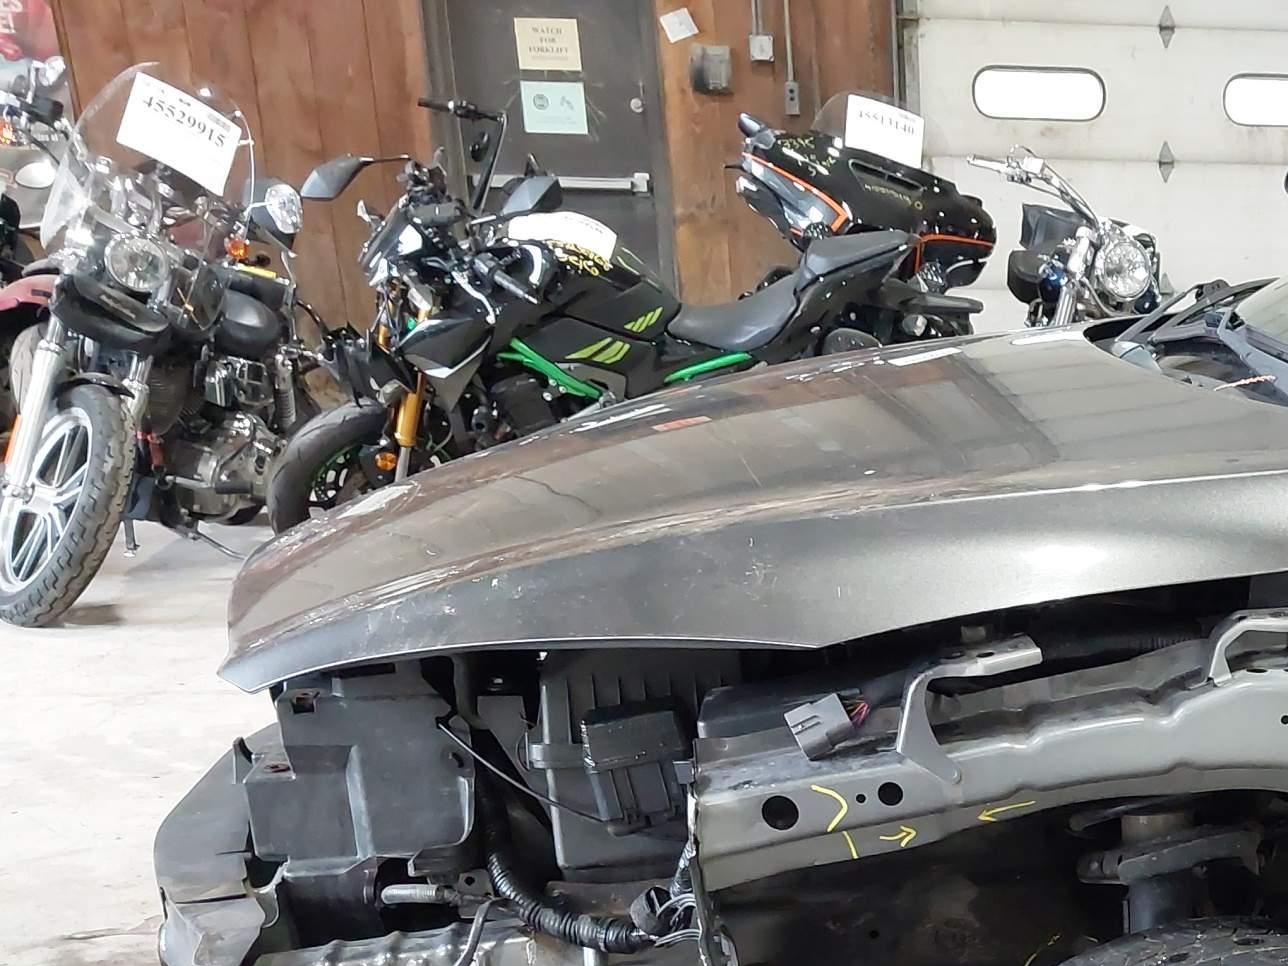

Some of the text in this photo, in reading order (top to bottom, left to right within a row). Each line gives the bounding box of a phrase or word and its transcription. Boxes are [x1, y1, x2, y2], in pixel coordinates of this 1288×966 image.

[532, 26, 563, 35] WATCH
[540, 36, 557, 44] FOR
[529, 45, 569, 54] FORKLIFT
[142, 95, 227, 148] 45529915
